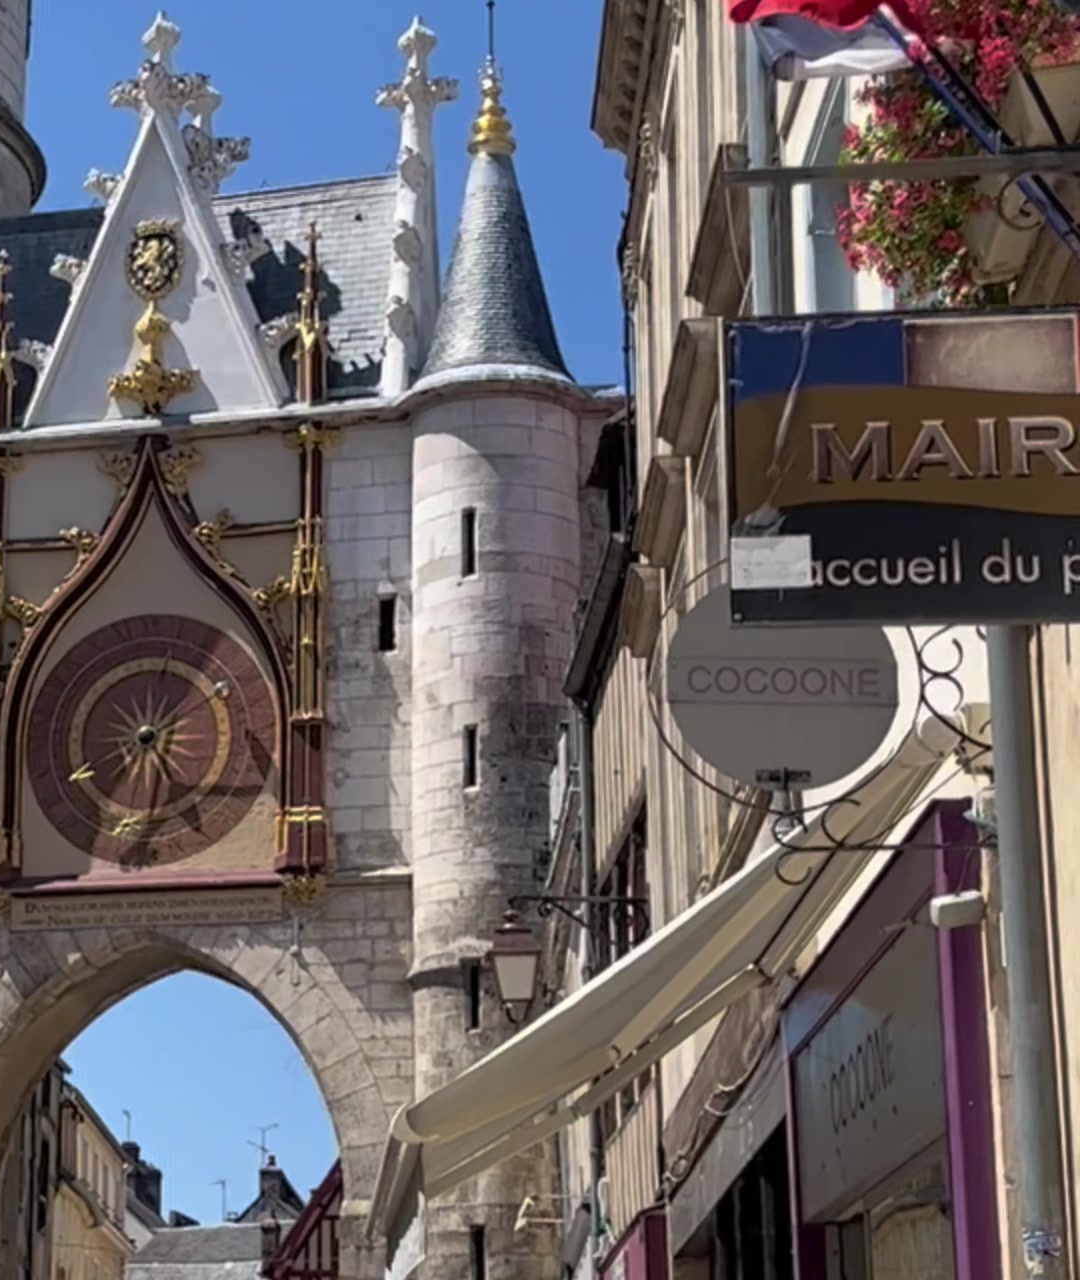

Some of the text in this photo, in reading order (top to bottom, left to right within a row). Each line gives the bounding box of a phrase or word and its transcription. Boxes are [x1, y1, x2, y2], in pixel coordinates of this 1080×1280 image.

[809, 415, 1080, 482] MAIR
[982, 537, 1041, 584] du
[687, 665, 880, 697] COCOONE
